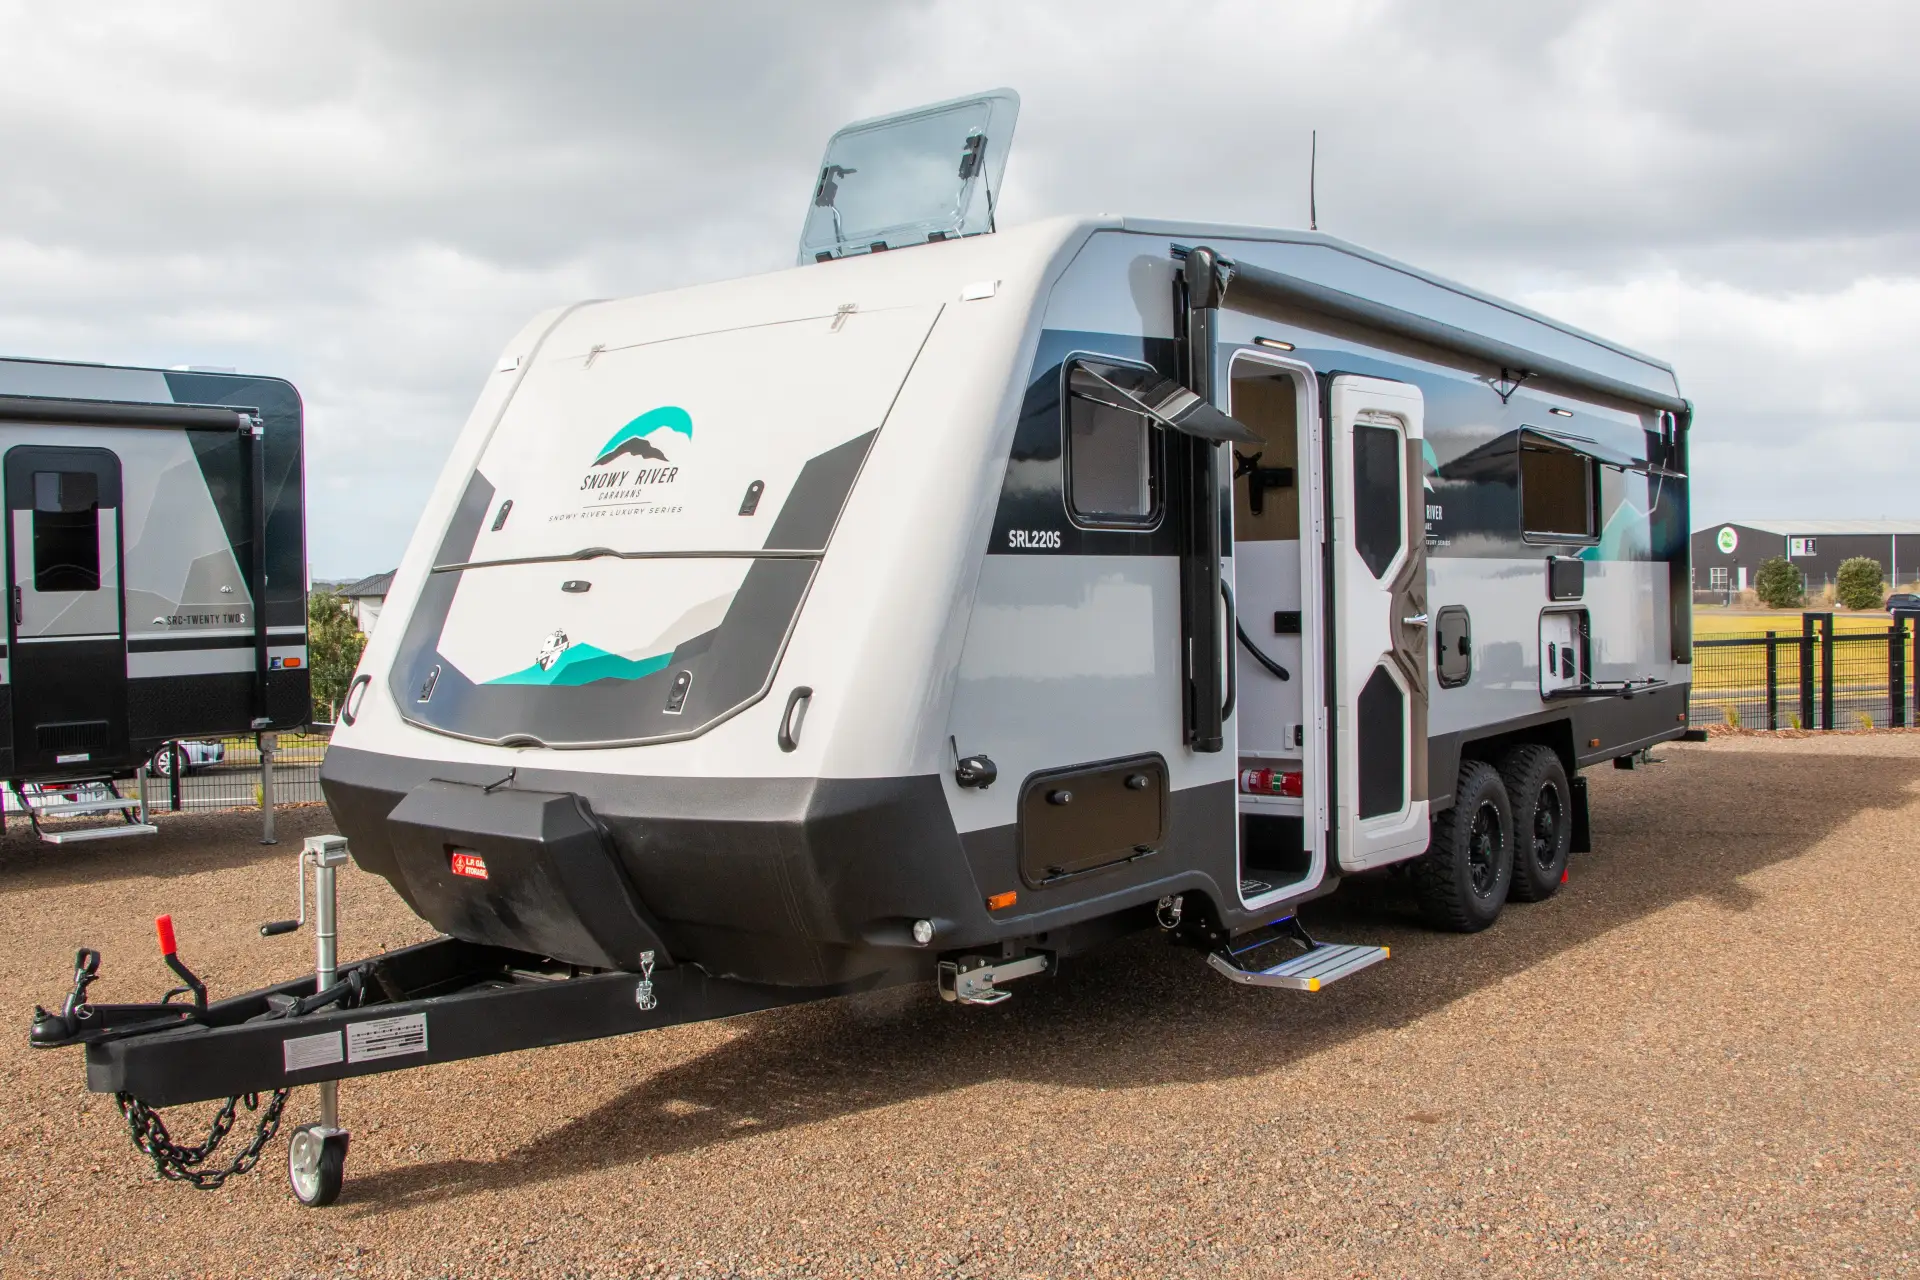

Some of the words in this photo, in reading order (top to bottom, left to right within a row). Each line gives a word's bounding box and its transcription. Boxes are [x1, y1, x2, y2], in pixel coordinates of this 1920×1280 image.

[580, 470, 630, 491] SNOWY
[634, 466, 679, 486] RIVER
[598, 488, 642, 501] CARAVANS
[548, 513, 578, 522] SNOWY
[580, 510, 607, 519] RIVER
[609, 508, 645, 517] LUXURY
[648, 506, 683, 514] SERIES
[1426, 505, 1443, 520] RIVER
[1008, 529, 1061, 548] SRL220S
[167, 614, 220, 625] SRC-TWENTY
